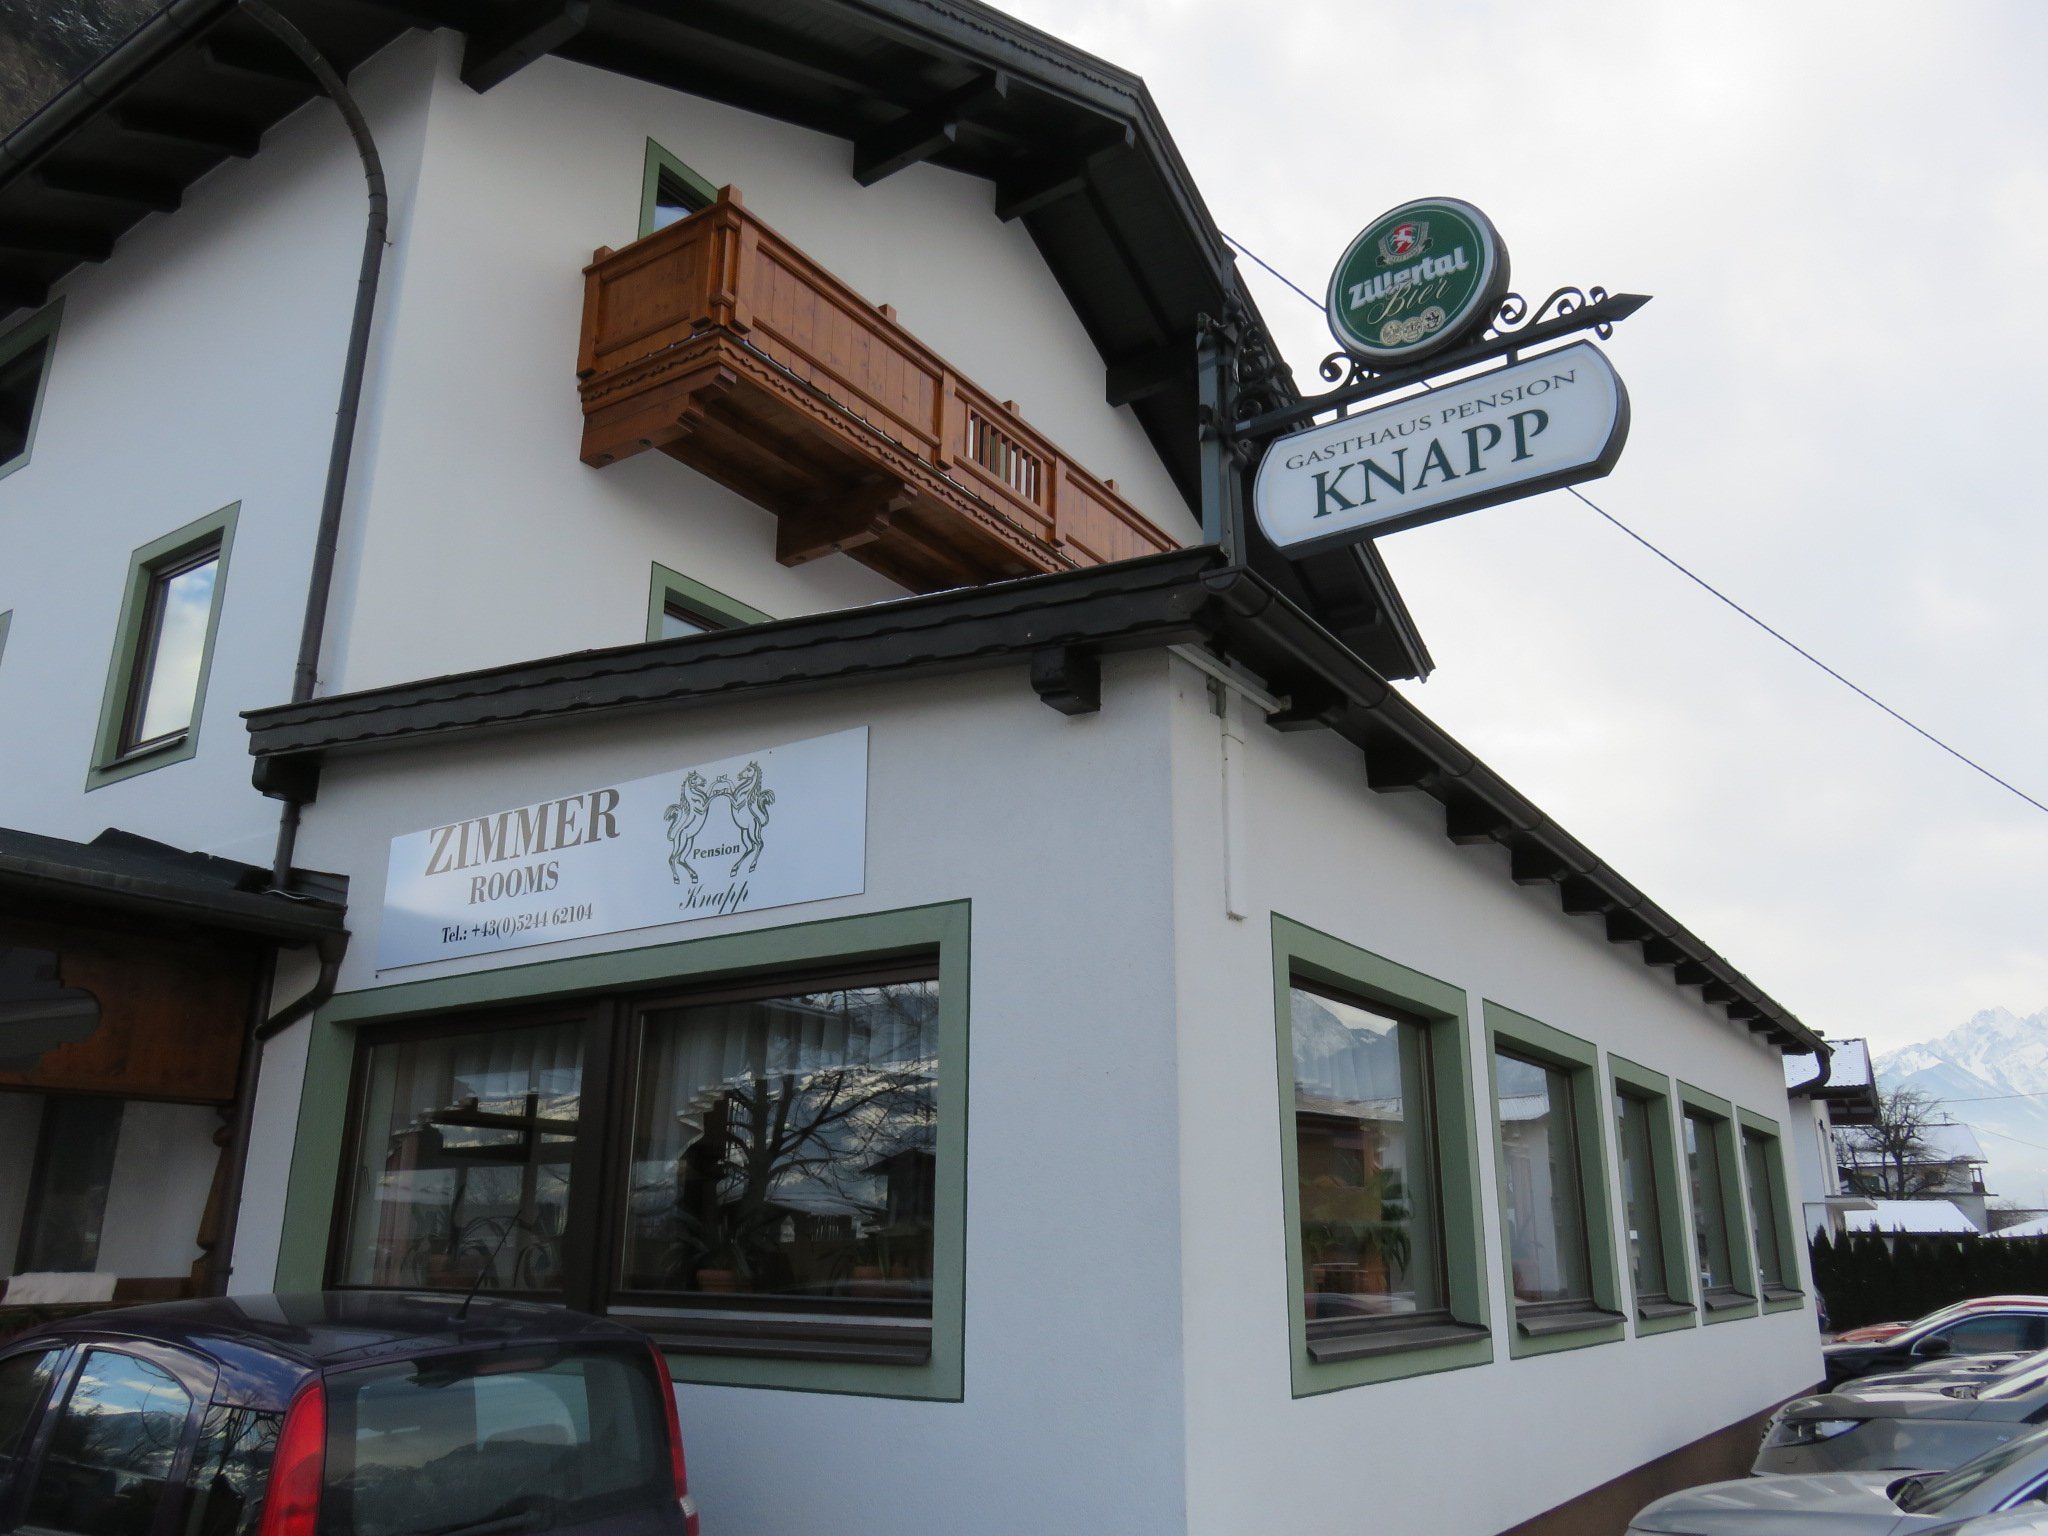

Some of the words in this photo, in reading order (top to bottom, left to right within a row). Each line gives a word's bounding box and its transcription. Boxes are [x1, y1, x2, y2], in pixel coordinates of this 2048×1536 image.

[1349, 246, 1470, 310] Zillertal
[1367, 277, 1453, 325] Bier
[1285, 415, 1432, 470] GASTHAUS
[1441, 369, 1577, 424] PENSION
[1311, 408, 1550, 519] KNAPP
[425, 788, 621, 876] ZIMMER
[693, 842, 741, 860] Pension
[468, 862, 560, 905] ROOMS
[679, 880, 750, 914] Knapp
[441, 925, 468, 944] Tel.:
[471, 907, 549, 940] +43(0)5244
[552, 902, 593, 925] 62104
